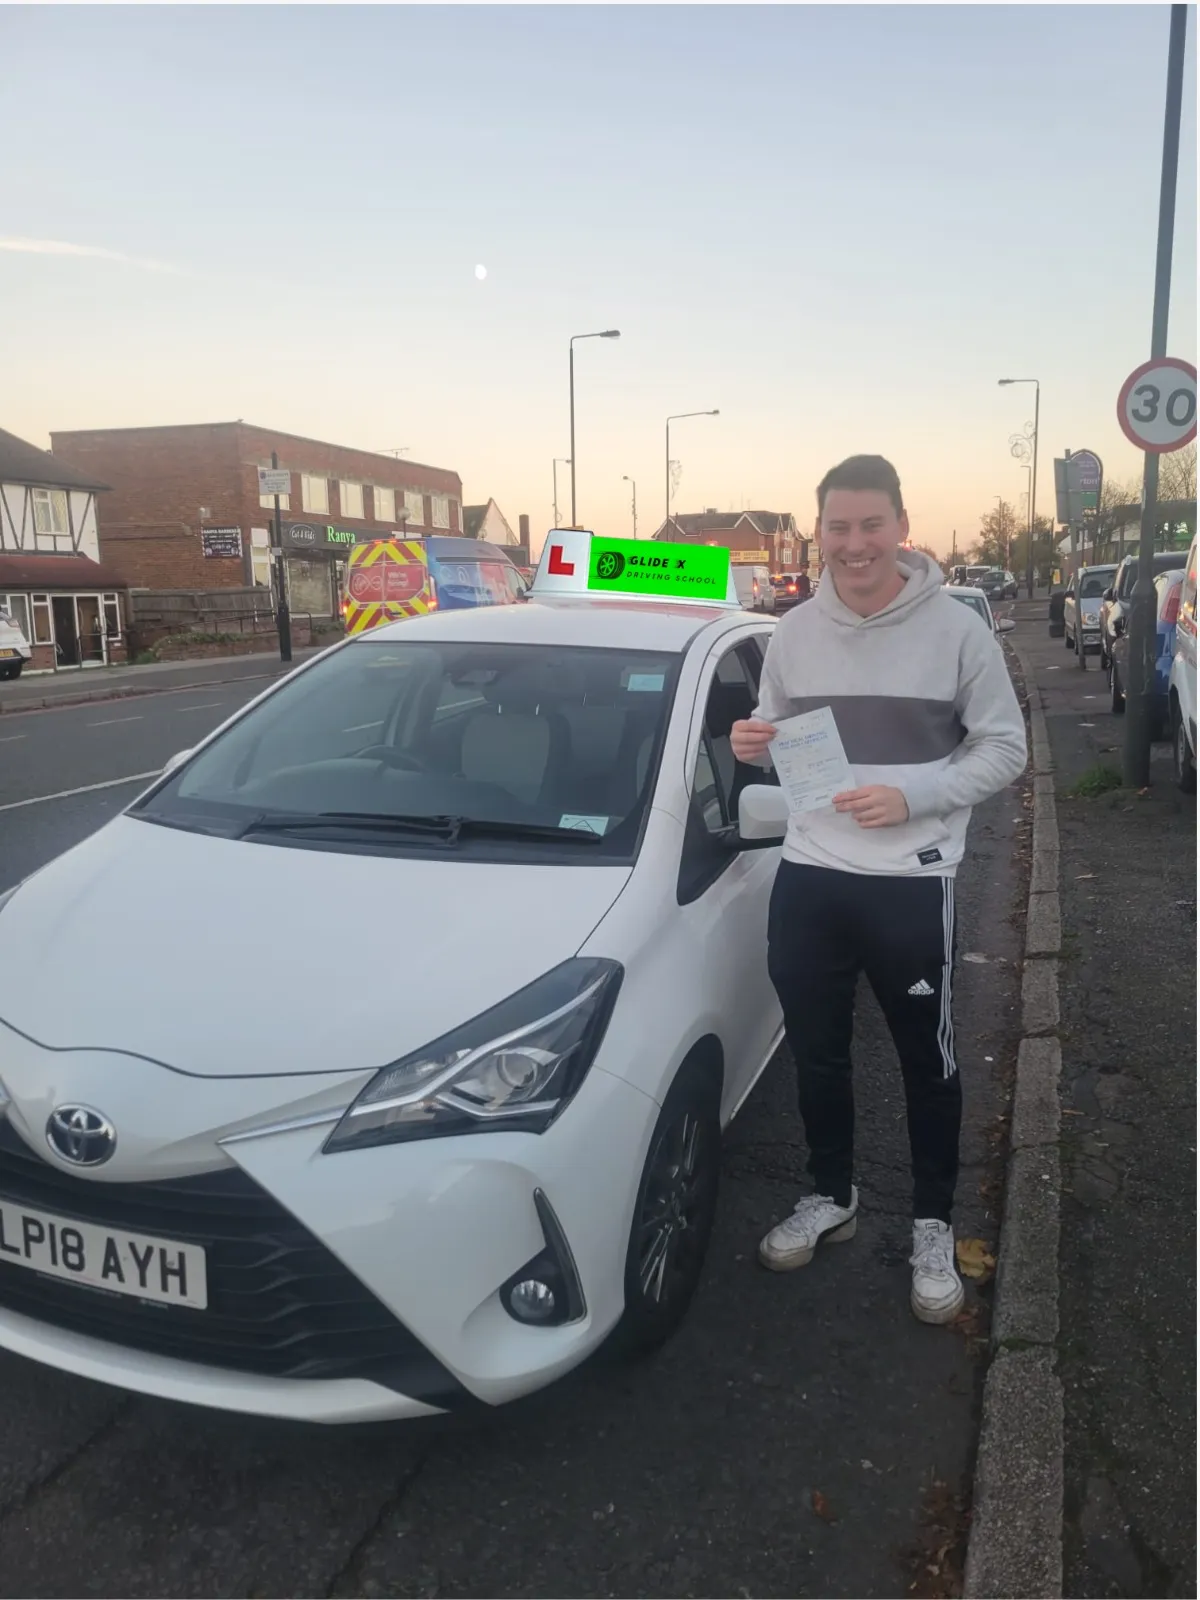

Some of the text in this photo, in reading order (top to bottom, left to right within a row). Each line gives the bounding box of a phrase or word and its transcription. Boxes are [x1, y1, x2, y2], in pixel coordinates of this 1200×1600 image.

[1131, 384, 1196, 426] 30
[327, 525, 356, 548] Ranya
[548, 546, 574, 576] L
[628, 555, 686, 569] GLIDE X
[626, 571, 716, 585] DRIVING SCHOOL
[907, 987, 935, 996] adidas
[0, 1208, 85, 1272] LP18
[102, 1237, 187, 1297] AYH
